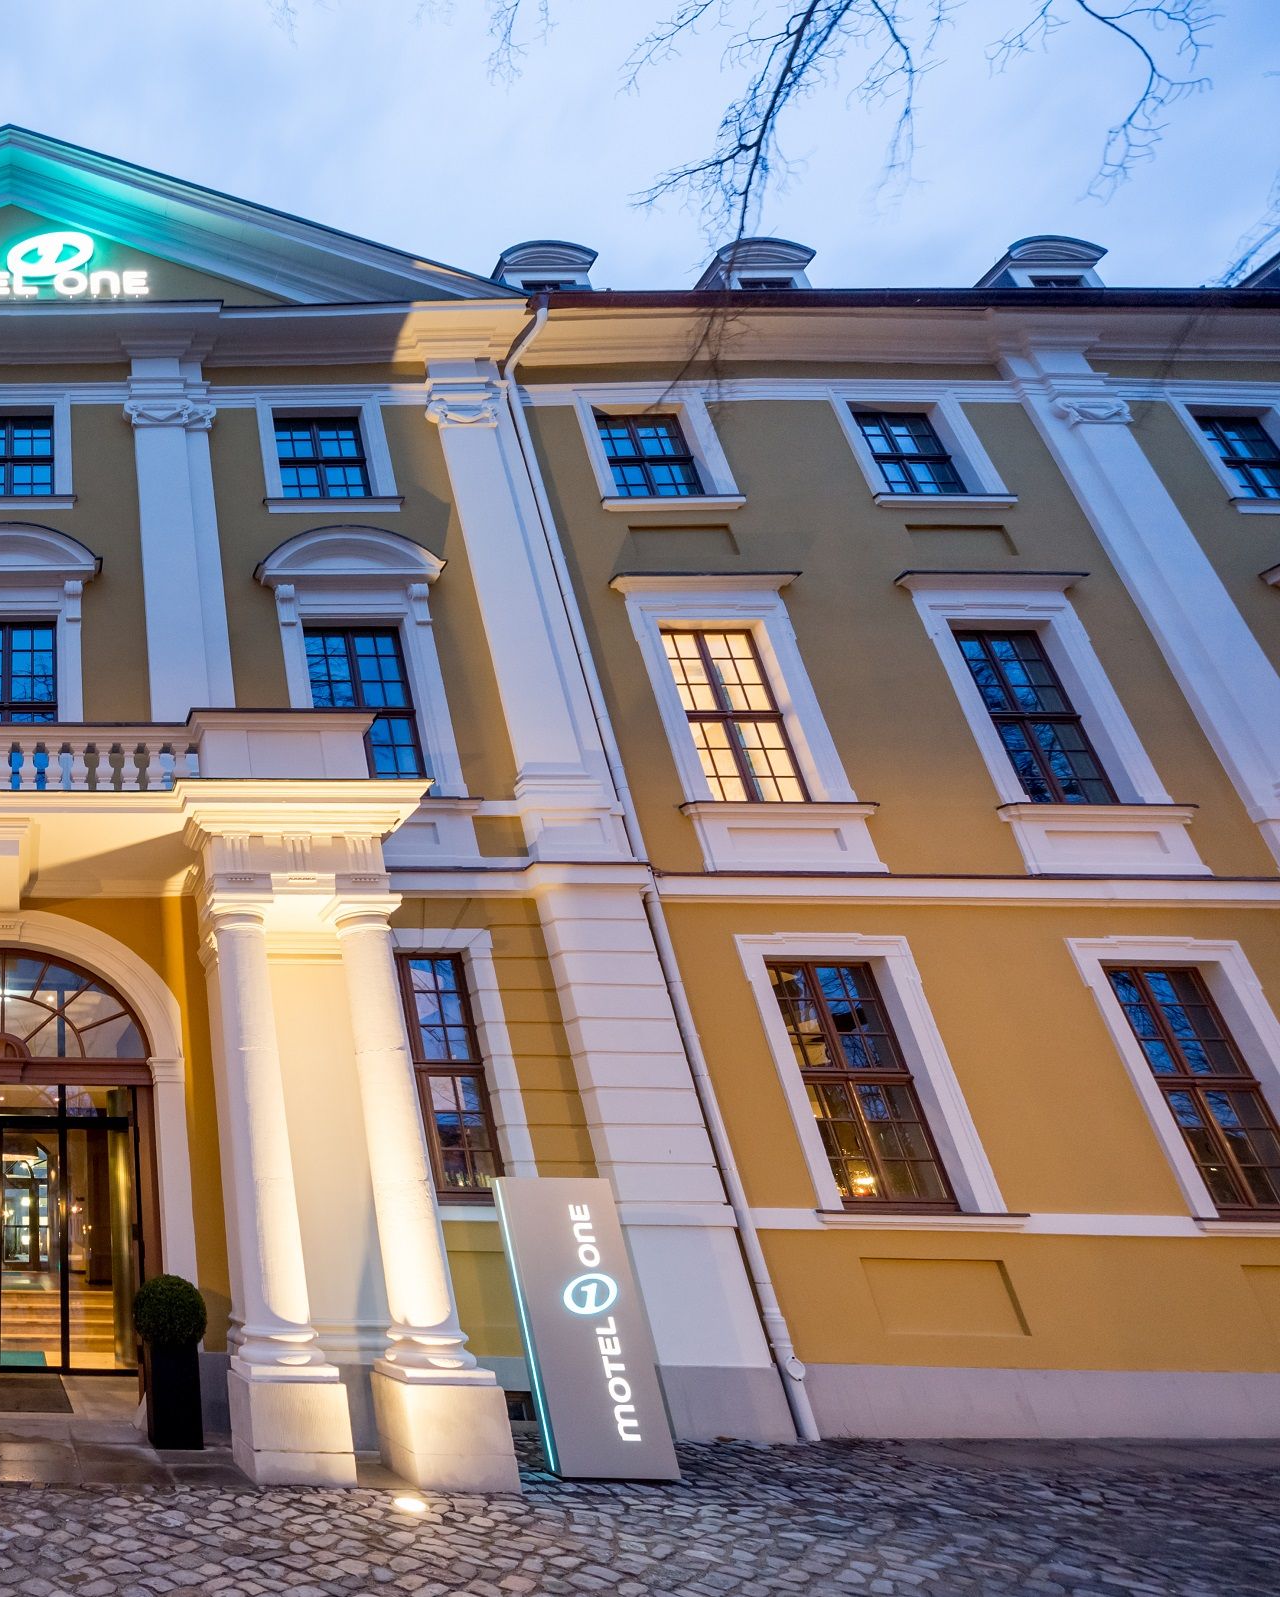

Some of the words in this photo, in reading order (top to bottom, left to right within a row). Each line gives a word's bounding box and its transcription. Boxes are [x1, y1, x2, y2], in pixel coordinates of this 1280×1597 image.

[53, 270, 149, 296] ONE
[568, 1203, 601, 1268] ONE
[595, 1316, 642, 1442] MOTEL
